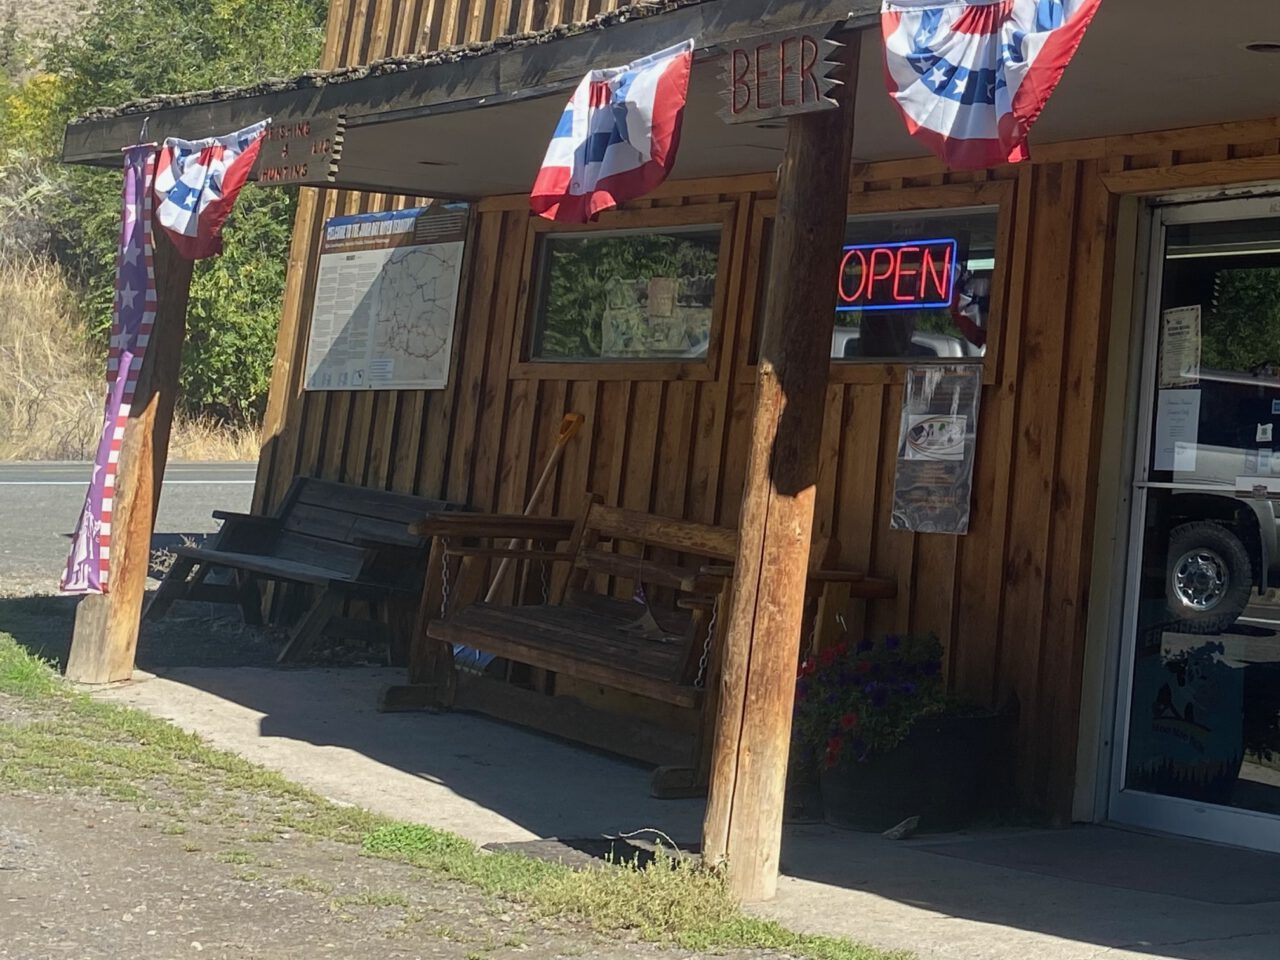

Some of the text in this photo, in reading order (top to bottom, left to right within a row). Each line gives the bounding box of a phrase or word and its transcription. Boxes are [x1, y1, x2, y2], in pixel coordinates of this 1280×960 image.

[731, 35, 822, 115] BEER
[260, 163, 308, 182] HUNTING
[837, 245, 953, 303] OPEN
